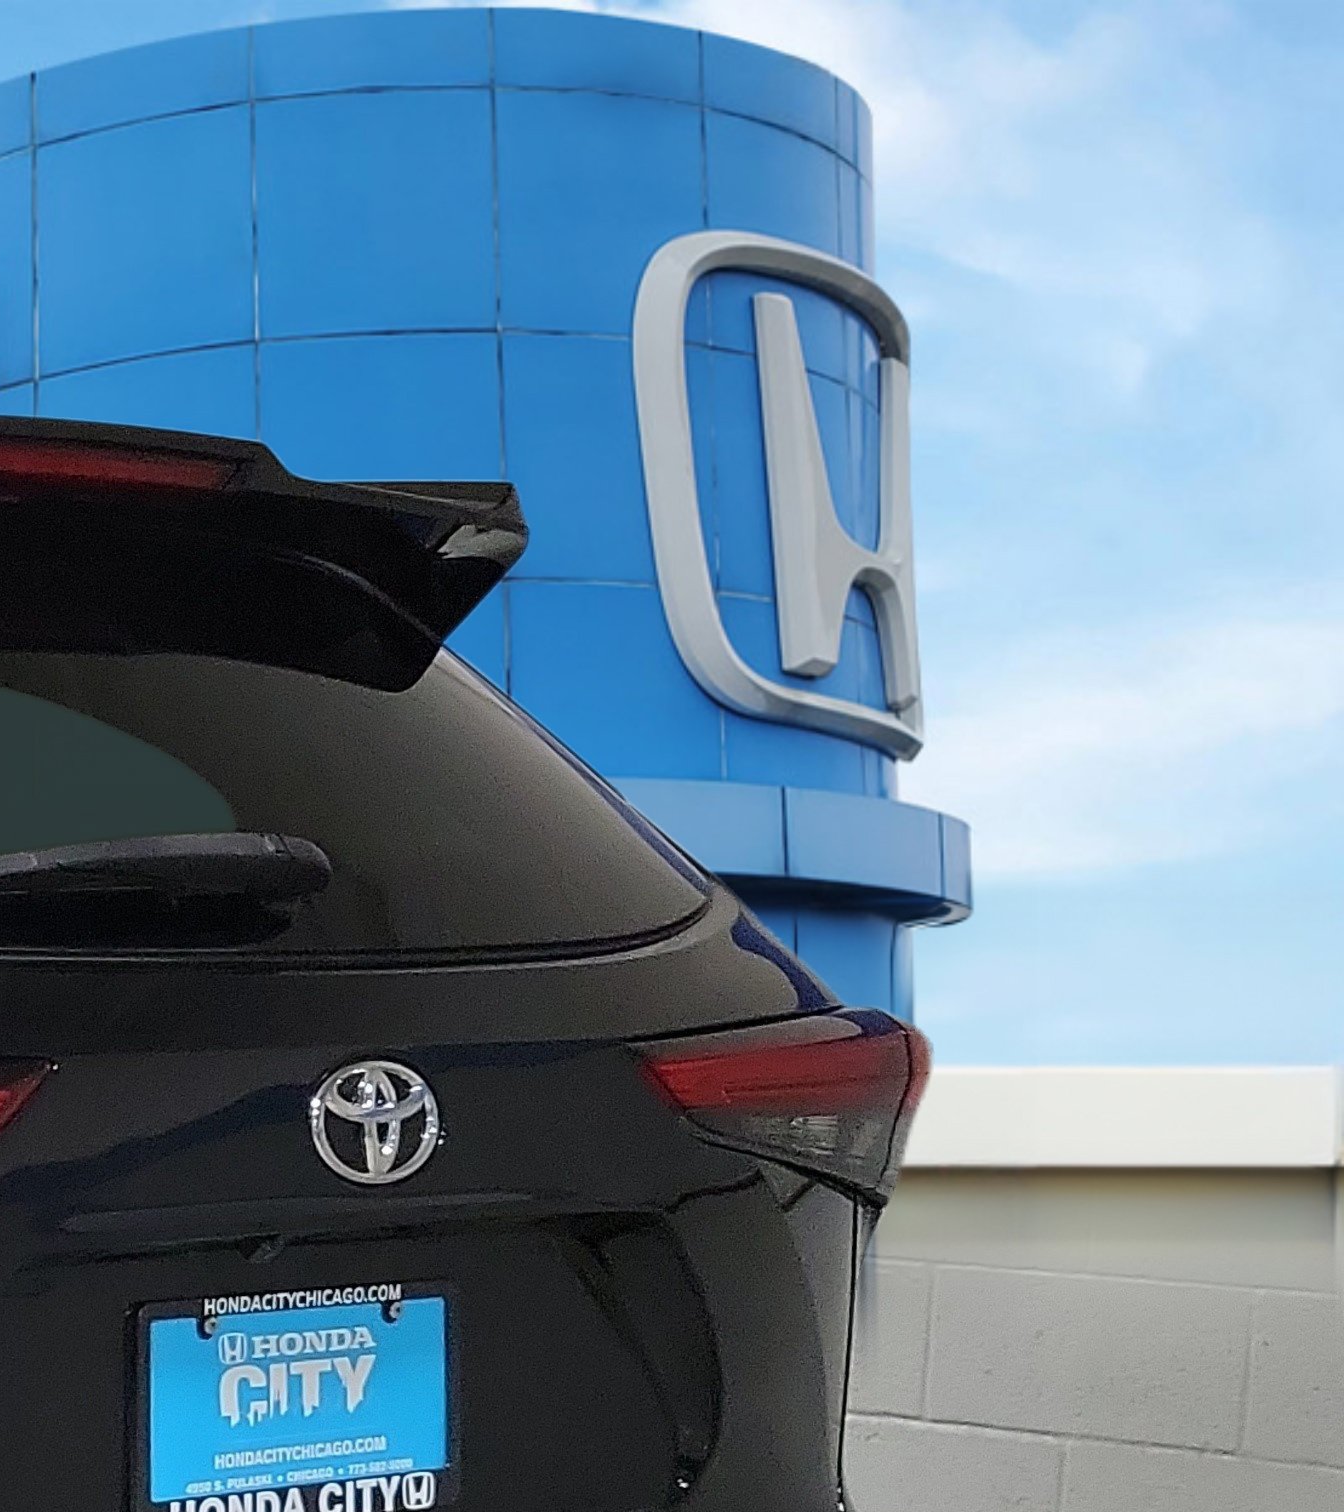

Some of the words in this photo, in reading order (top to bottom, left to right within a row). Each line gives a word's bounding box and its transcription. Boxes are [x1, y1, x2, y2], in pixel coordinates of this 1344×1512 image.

[204, 1283, 402, 1316] HONDACITYCHICAGO.COM
[252, 1326, 377, 1359] HONDA
[219, 1354, 376, 1428] CITY
[214, 1436, 387, 1470] HONDACITYCHICAGO.COM
